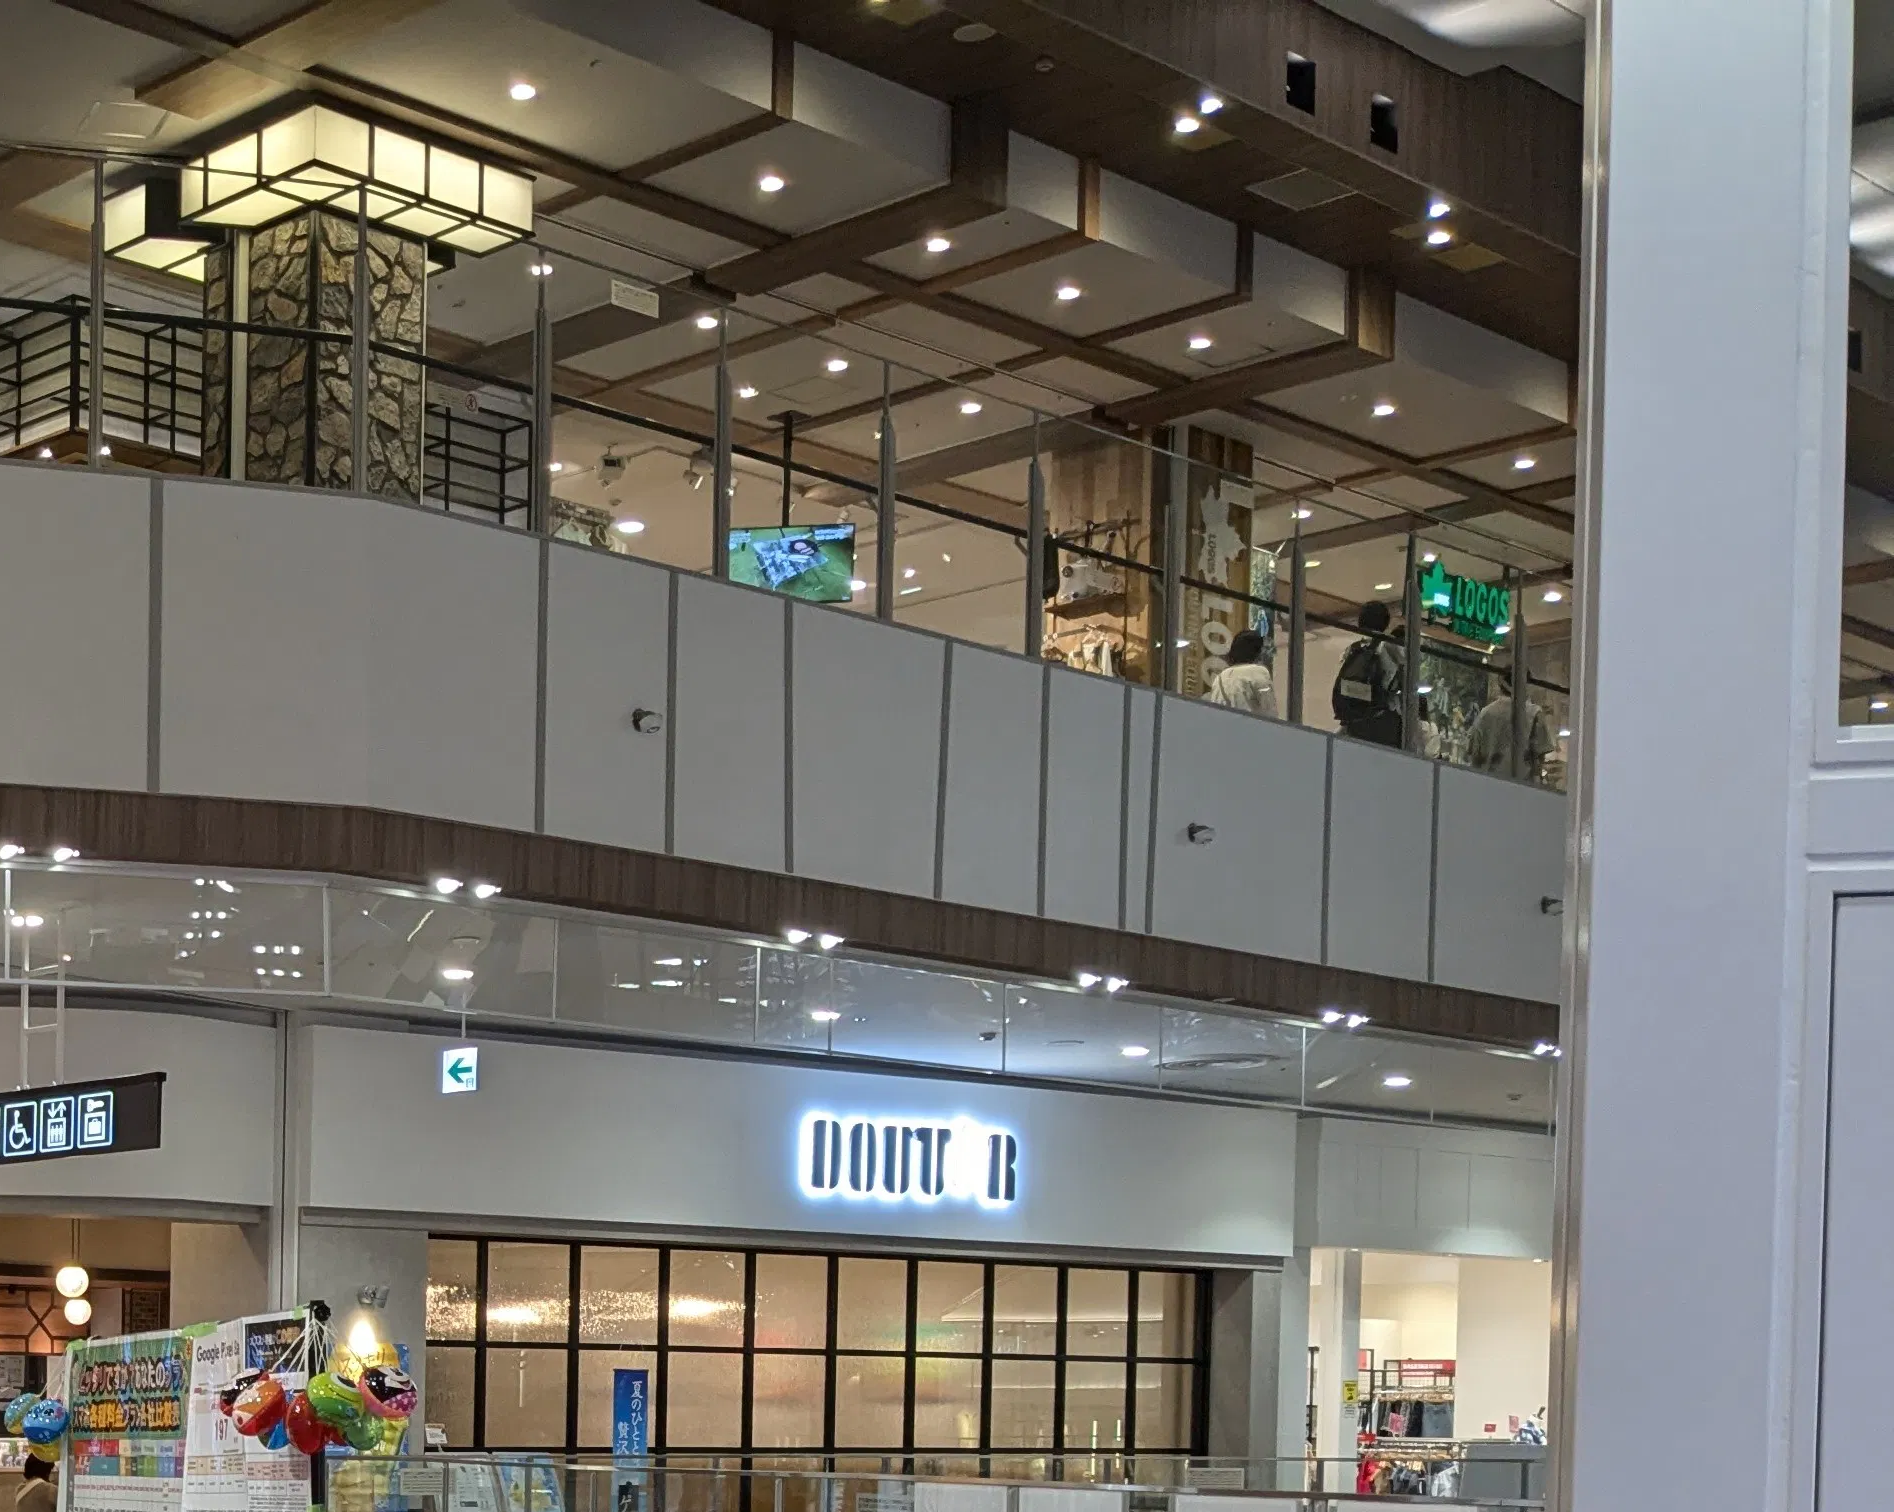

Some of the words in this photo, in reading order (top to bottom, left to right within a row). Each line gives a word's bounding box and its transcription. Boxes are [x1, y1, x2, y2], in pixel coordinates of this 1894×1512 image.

[1455, 577, 1511, 626] LOGOS
[810, 1118, 1017, 1201] DOUTR
[196, 1343, 220, 1365] Google
[214, 1418, 228, 1441] 197
